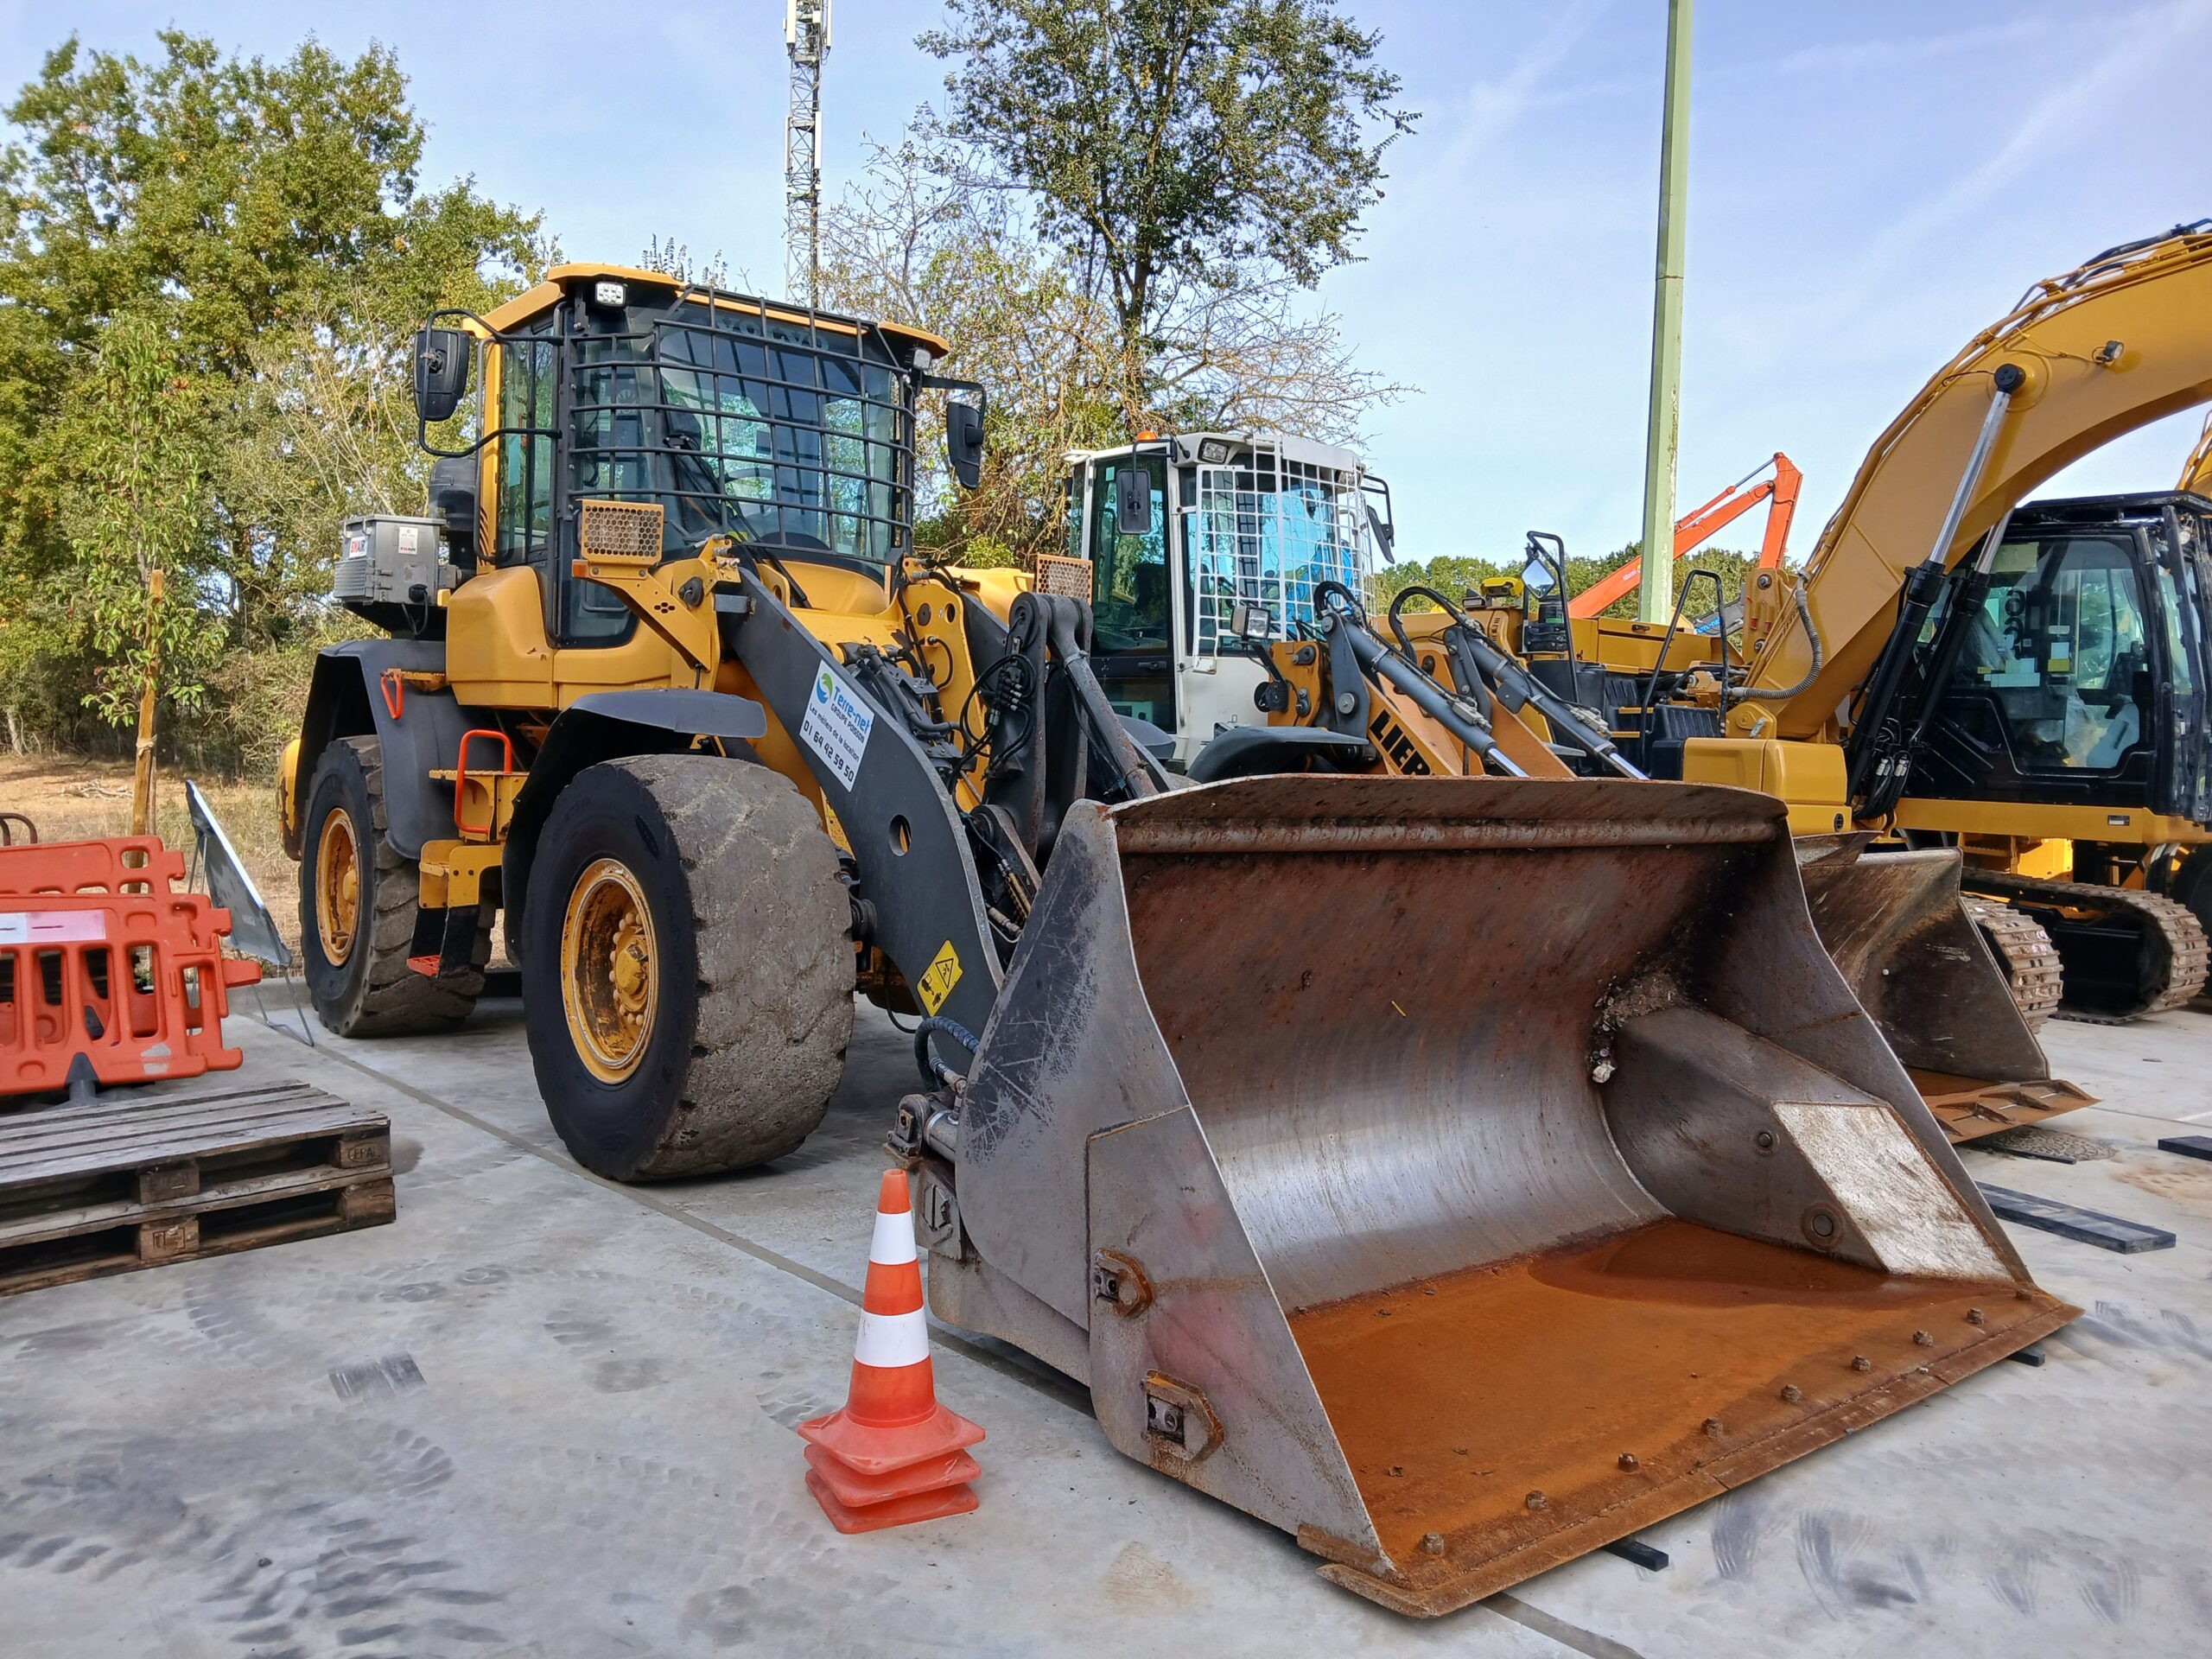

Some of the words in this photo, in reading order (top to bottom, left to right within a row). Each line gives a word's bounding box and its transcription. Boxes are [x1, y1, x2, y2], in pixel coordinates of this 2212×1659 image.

[715, 315, 830, 352] VOLVO
[831, 703, 848, 725] GROUPE
[848, 721, 864, 743] POISSON
[834, 686, 870, 734] Terre-net
[804, 720, 813, 735] 01
[813, 731, 823, 748] 64
[823, 742, 833, 759] 42
[833, 753, 844, 770] 59
[843, 765, 855, 783] 50
[817, 713, 833, 732] métiers
[832, 729, 839, 740] de
[838, 734, 843, 744] la
[842, 739, 860, 762] location
